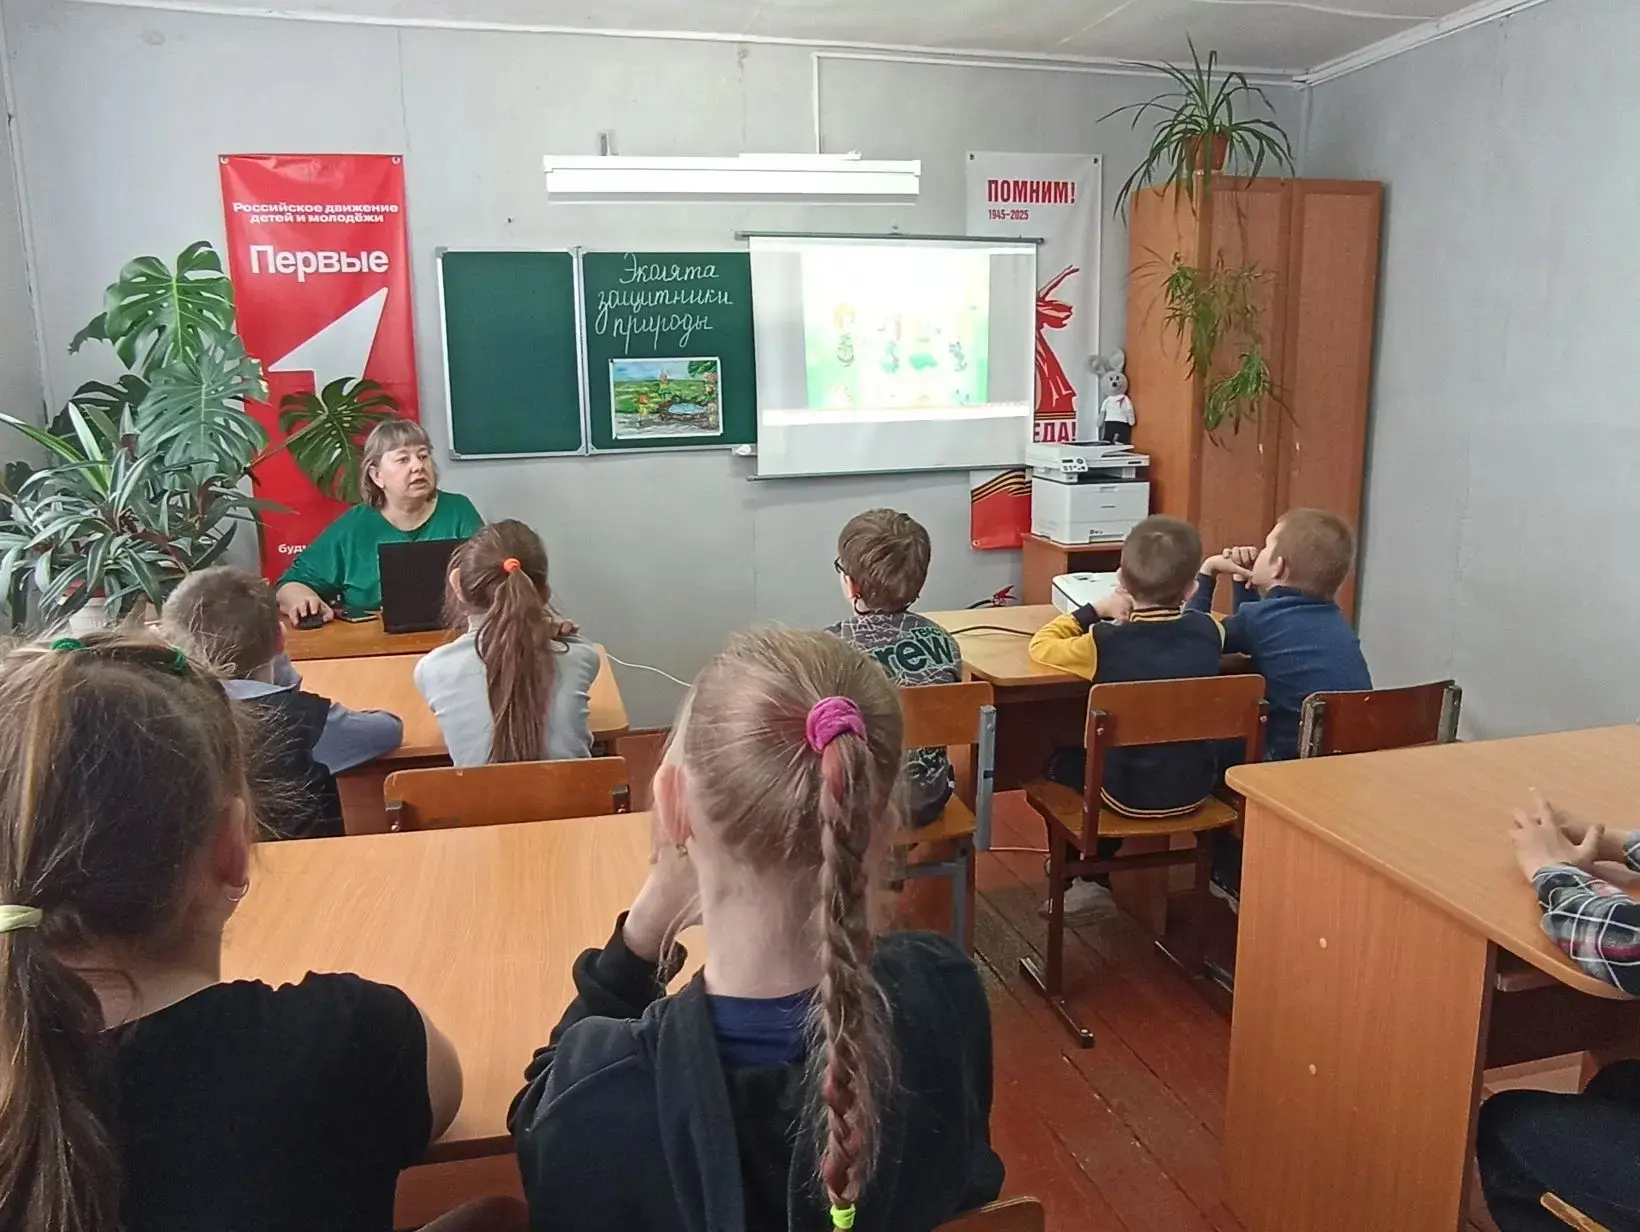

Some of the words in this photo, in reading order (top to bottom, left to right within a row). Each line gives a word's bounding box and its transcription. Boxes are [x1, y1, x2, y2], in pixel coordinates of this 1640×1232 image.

[987, 179, 1076, 204] ПОМНИМ!
[232, 202, 323, 213] Российское
[325, 203, 399, 213] движение
[250, 213, 293, 223] детей
[296, 214, 306, 222] и
[308, 213, 384, 223] молодёжи
[249, 244, 389, 282] Первые
[619, 252, 719, 284] Эколята
[595, 289, 733, 335] защитники
[613, 313, 714, 355] природы
[278, 543, 306, 555] буд
